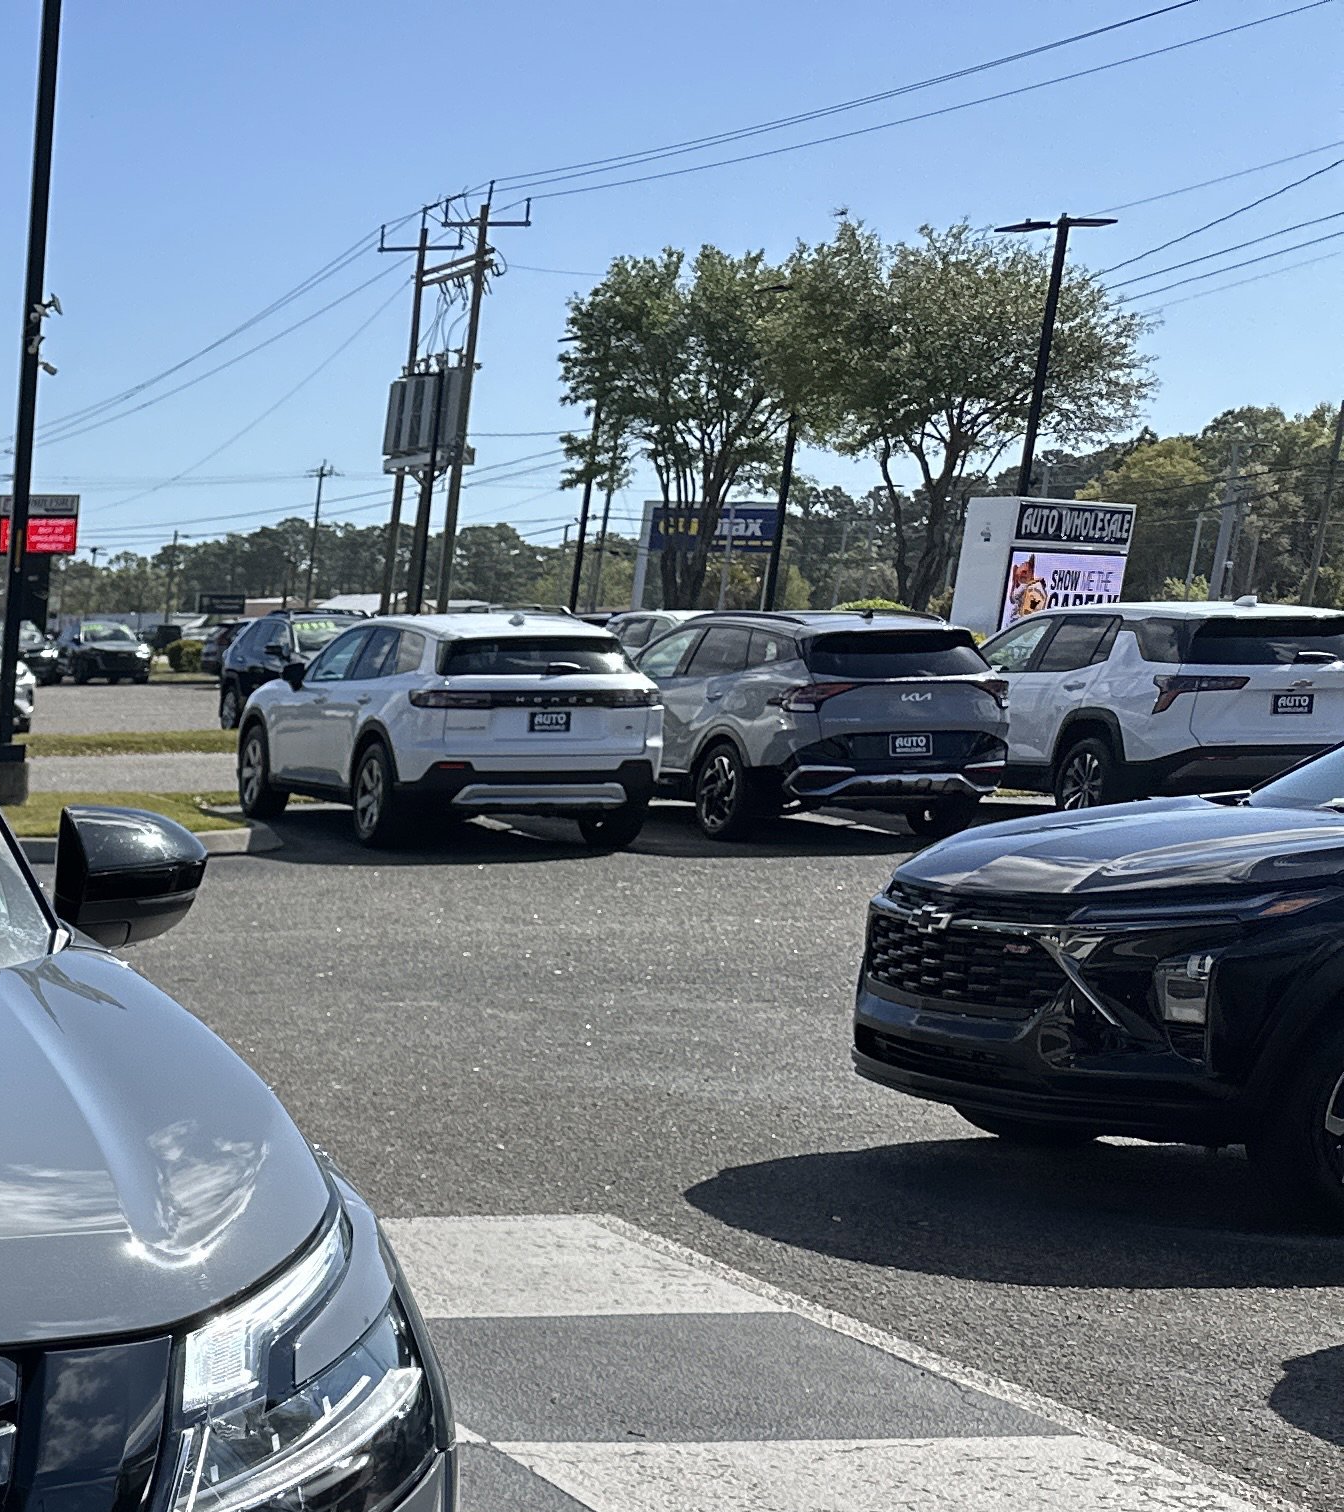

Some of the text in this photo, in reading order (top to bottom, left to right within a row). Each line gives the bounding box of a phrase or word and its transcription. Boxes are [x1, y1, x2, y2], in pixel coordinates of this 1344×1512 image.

[1021, 508, 1131, 539] AUTO WHOLESALE
[1050, 569, 1081, 591] SHOW
[1278, 696, 1309, 707] AUTO
[534, 713, 566, 725] AUTO
[896, 736, 926, 747] AUTO
